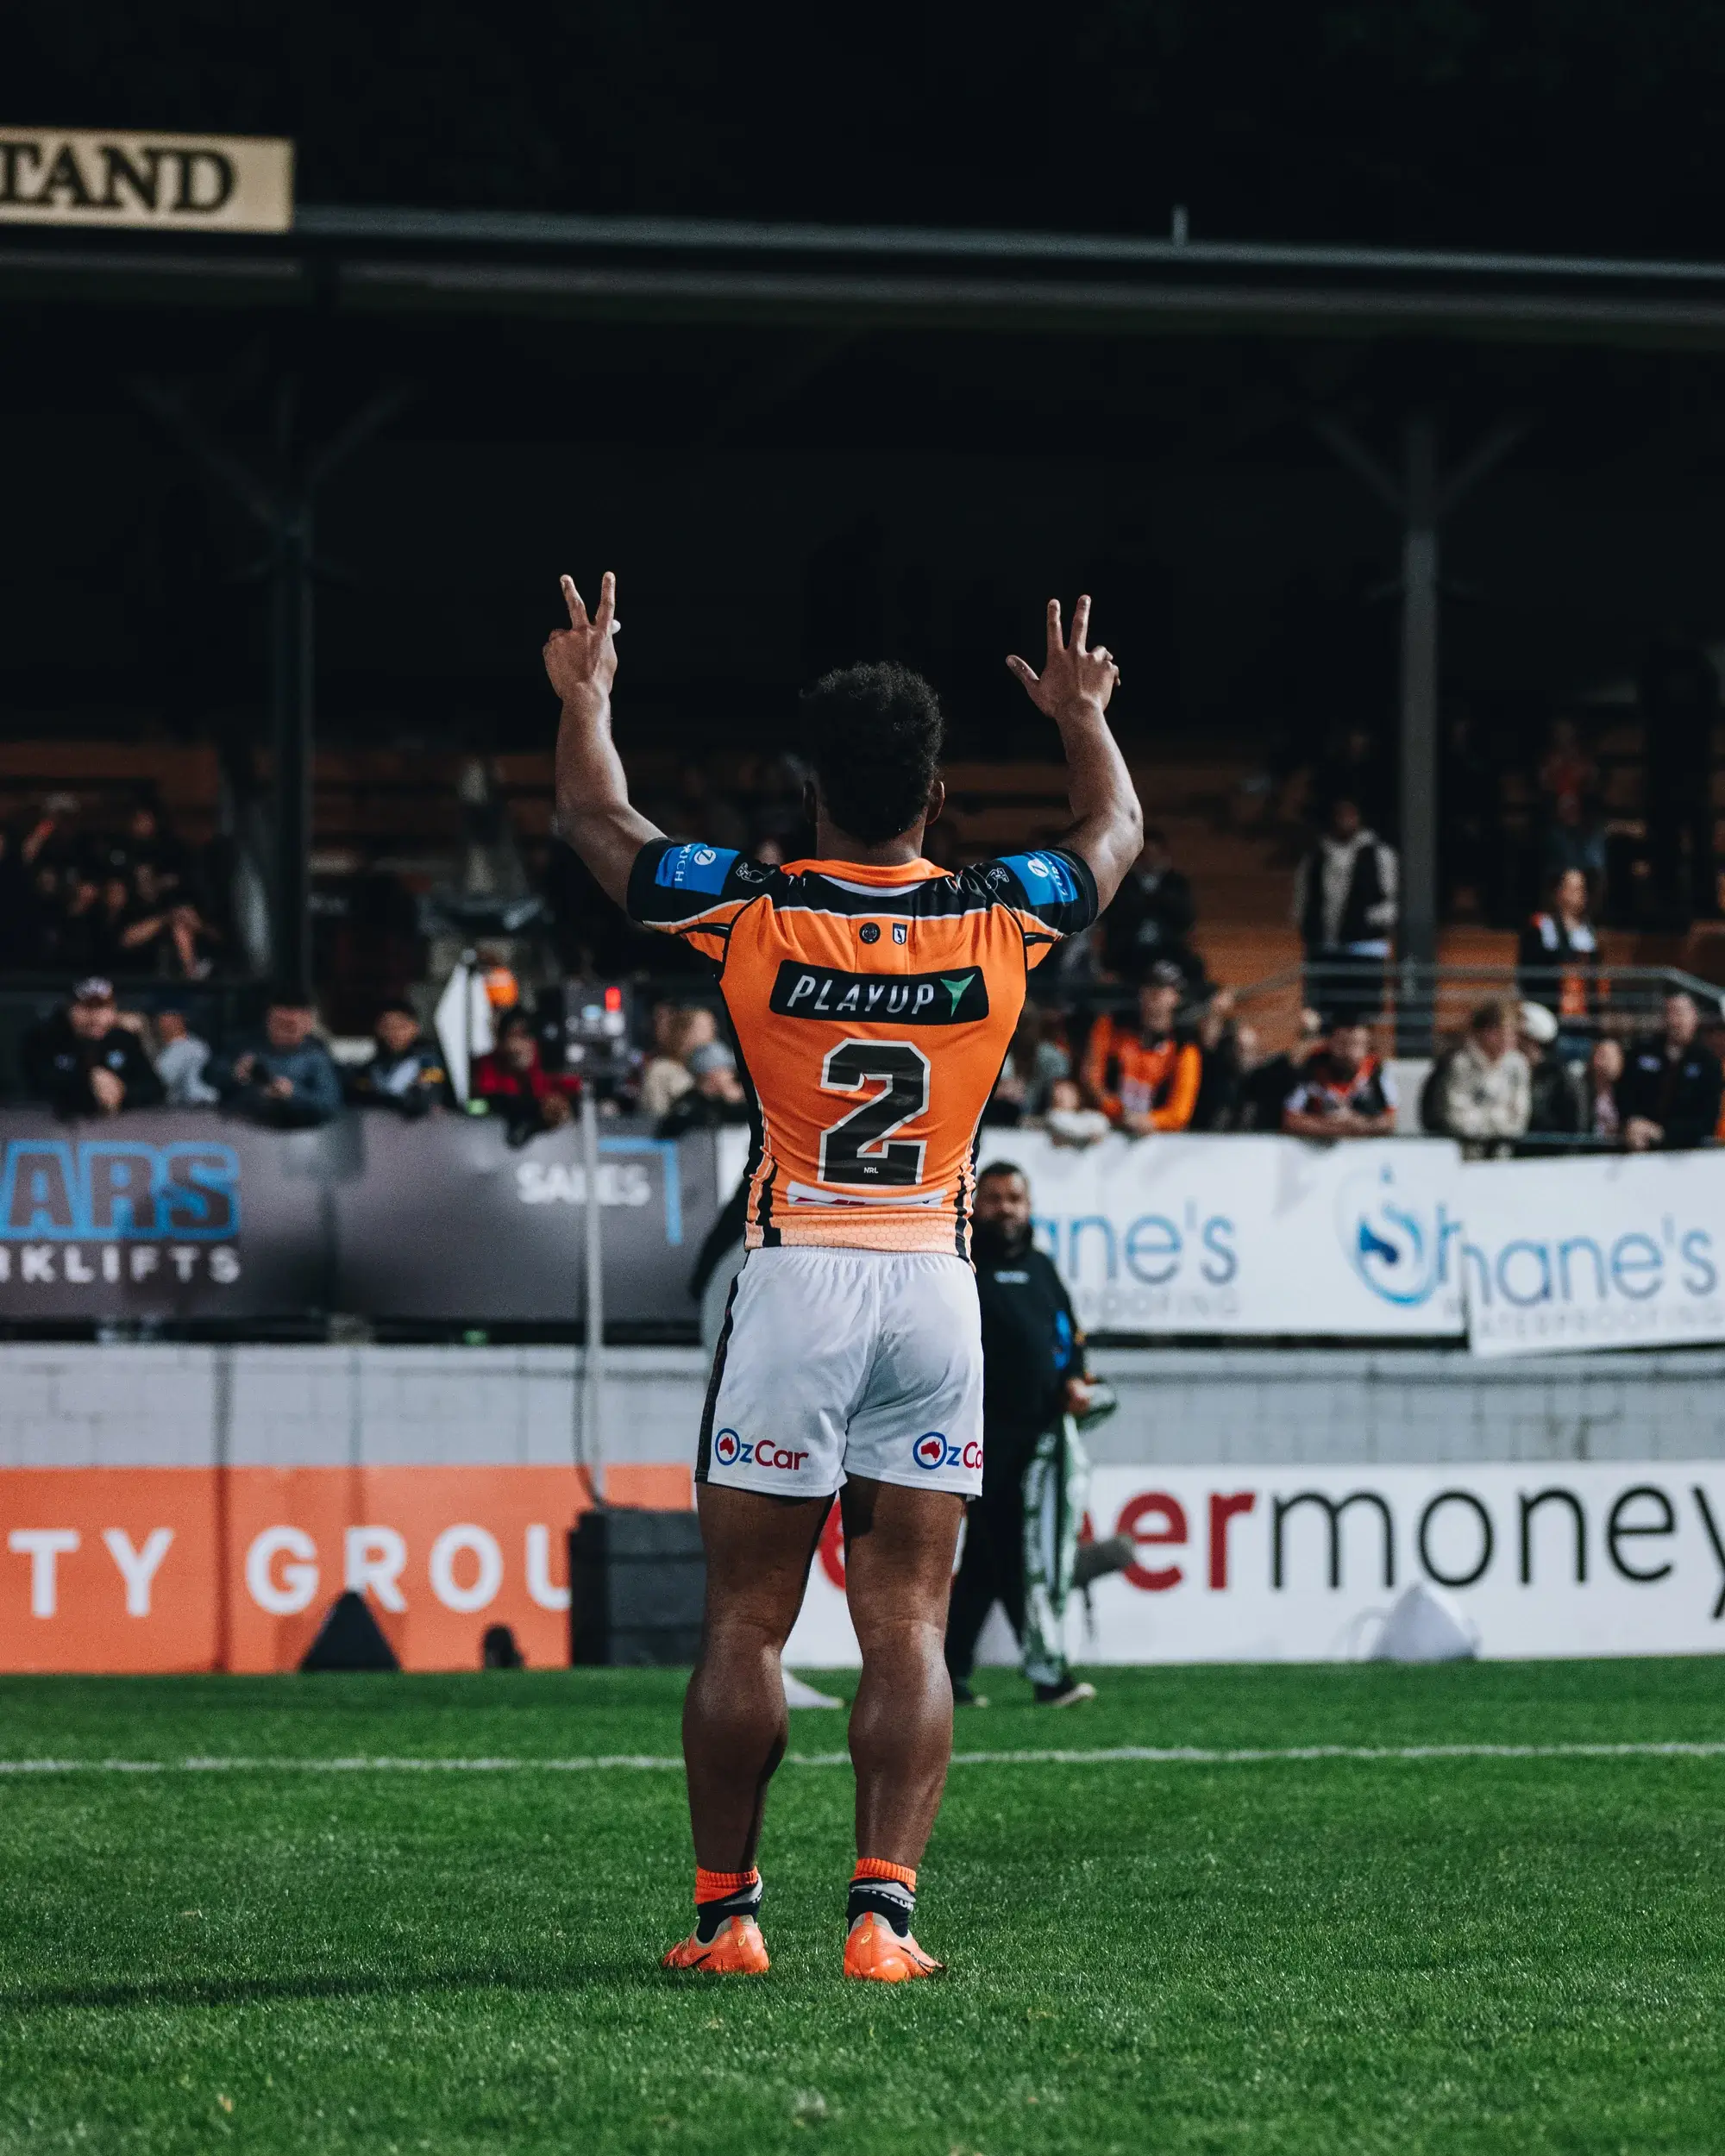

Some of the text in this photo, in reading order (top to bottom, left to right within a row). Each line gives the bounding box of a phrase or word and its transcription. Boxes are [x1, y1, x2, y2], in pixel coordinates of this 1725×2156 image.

[0, 141, 239, 214] TAND
[786, 975, 935, 1015] PLAYUP
[819, 1037, 931, 1186] 2
[0, 1138, 242, 1242] ARS
[863, 1166, 879, 1175] NRL
[715, 1428, 809, 1470] OzCar
[9, 1528, 172, 1619] TY
